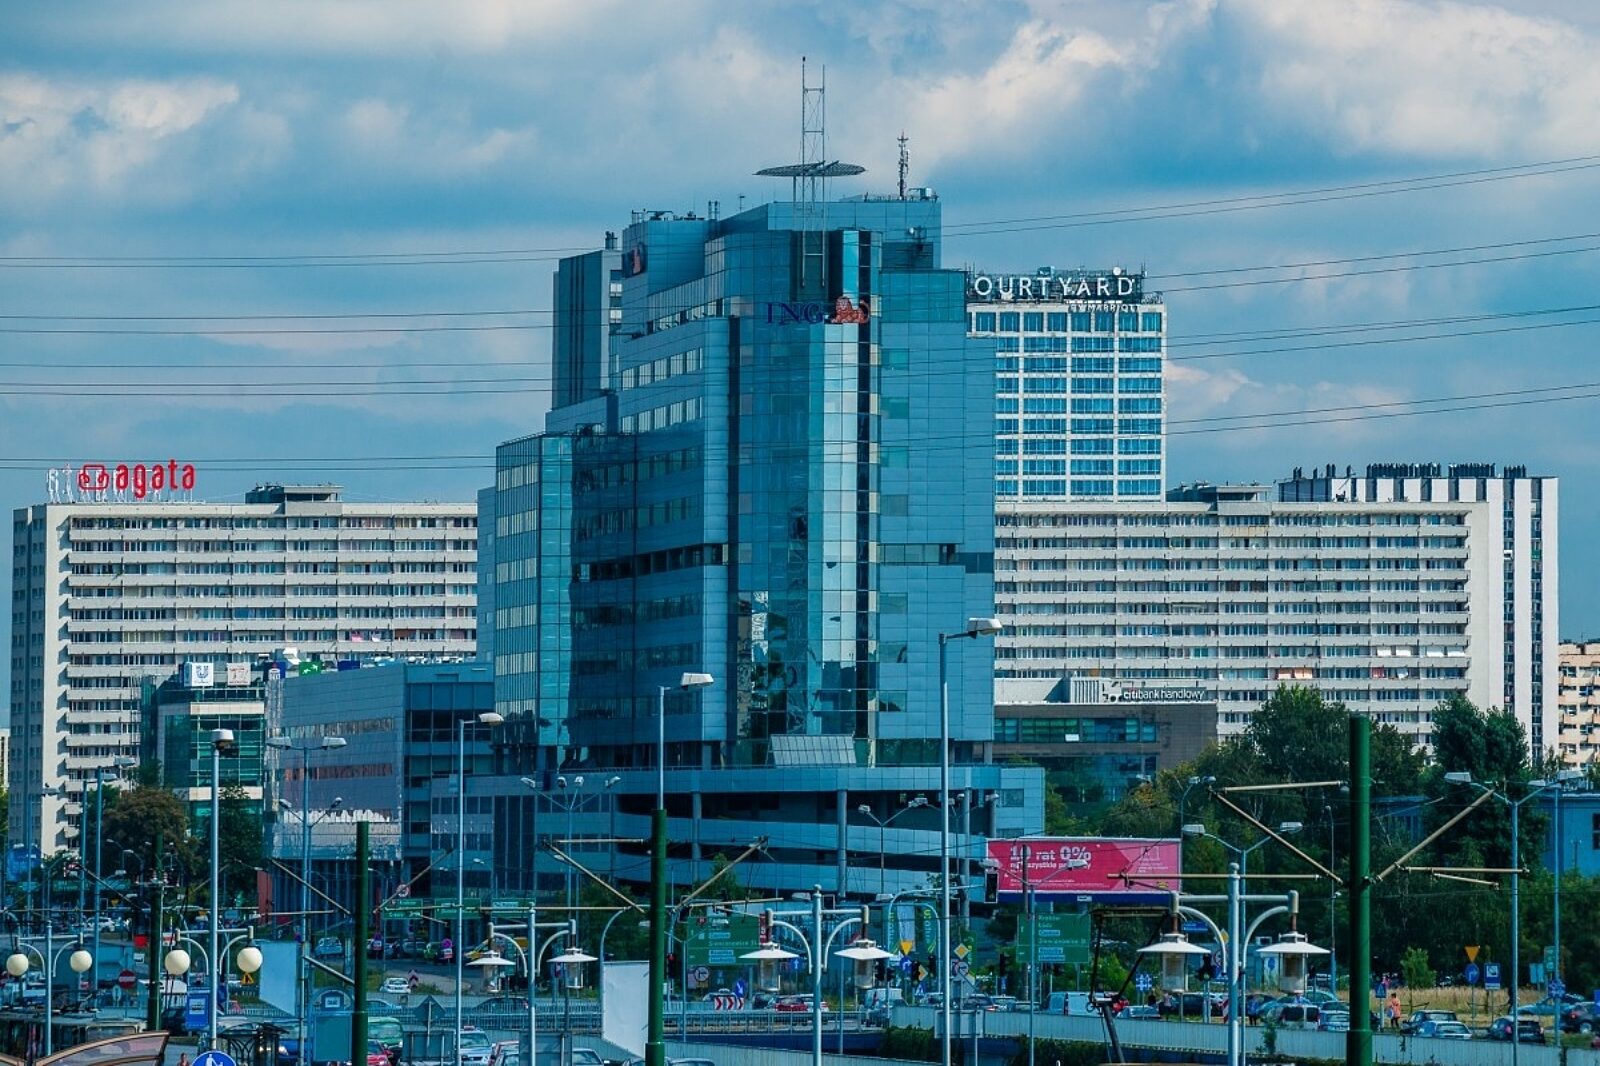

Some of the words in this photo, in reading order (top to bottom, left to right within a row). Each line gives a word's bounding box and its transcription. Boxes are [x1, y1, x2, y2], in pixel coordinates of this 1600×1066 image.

[966, 276, 1135, 296] OURTYARD
[766, 302, 824, 324] ING
[116, 459, 195, 498] agata
[1123, 688, 1160, 700] citibank
[1160, 688, 1205, 701] handlowy
[1036, 849, 1056, 861] rat
[1060, 846, 1092, 862] 0%
